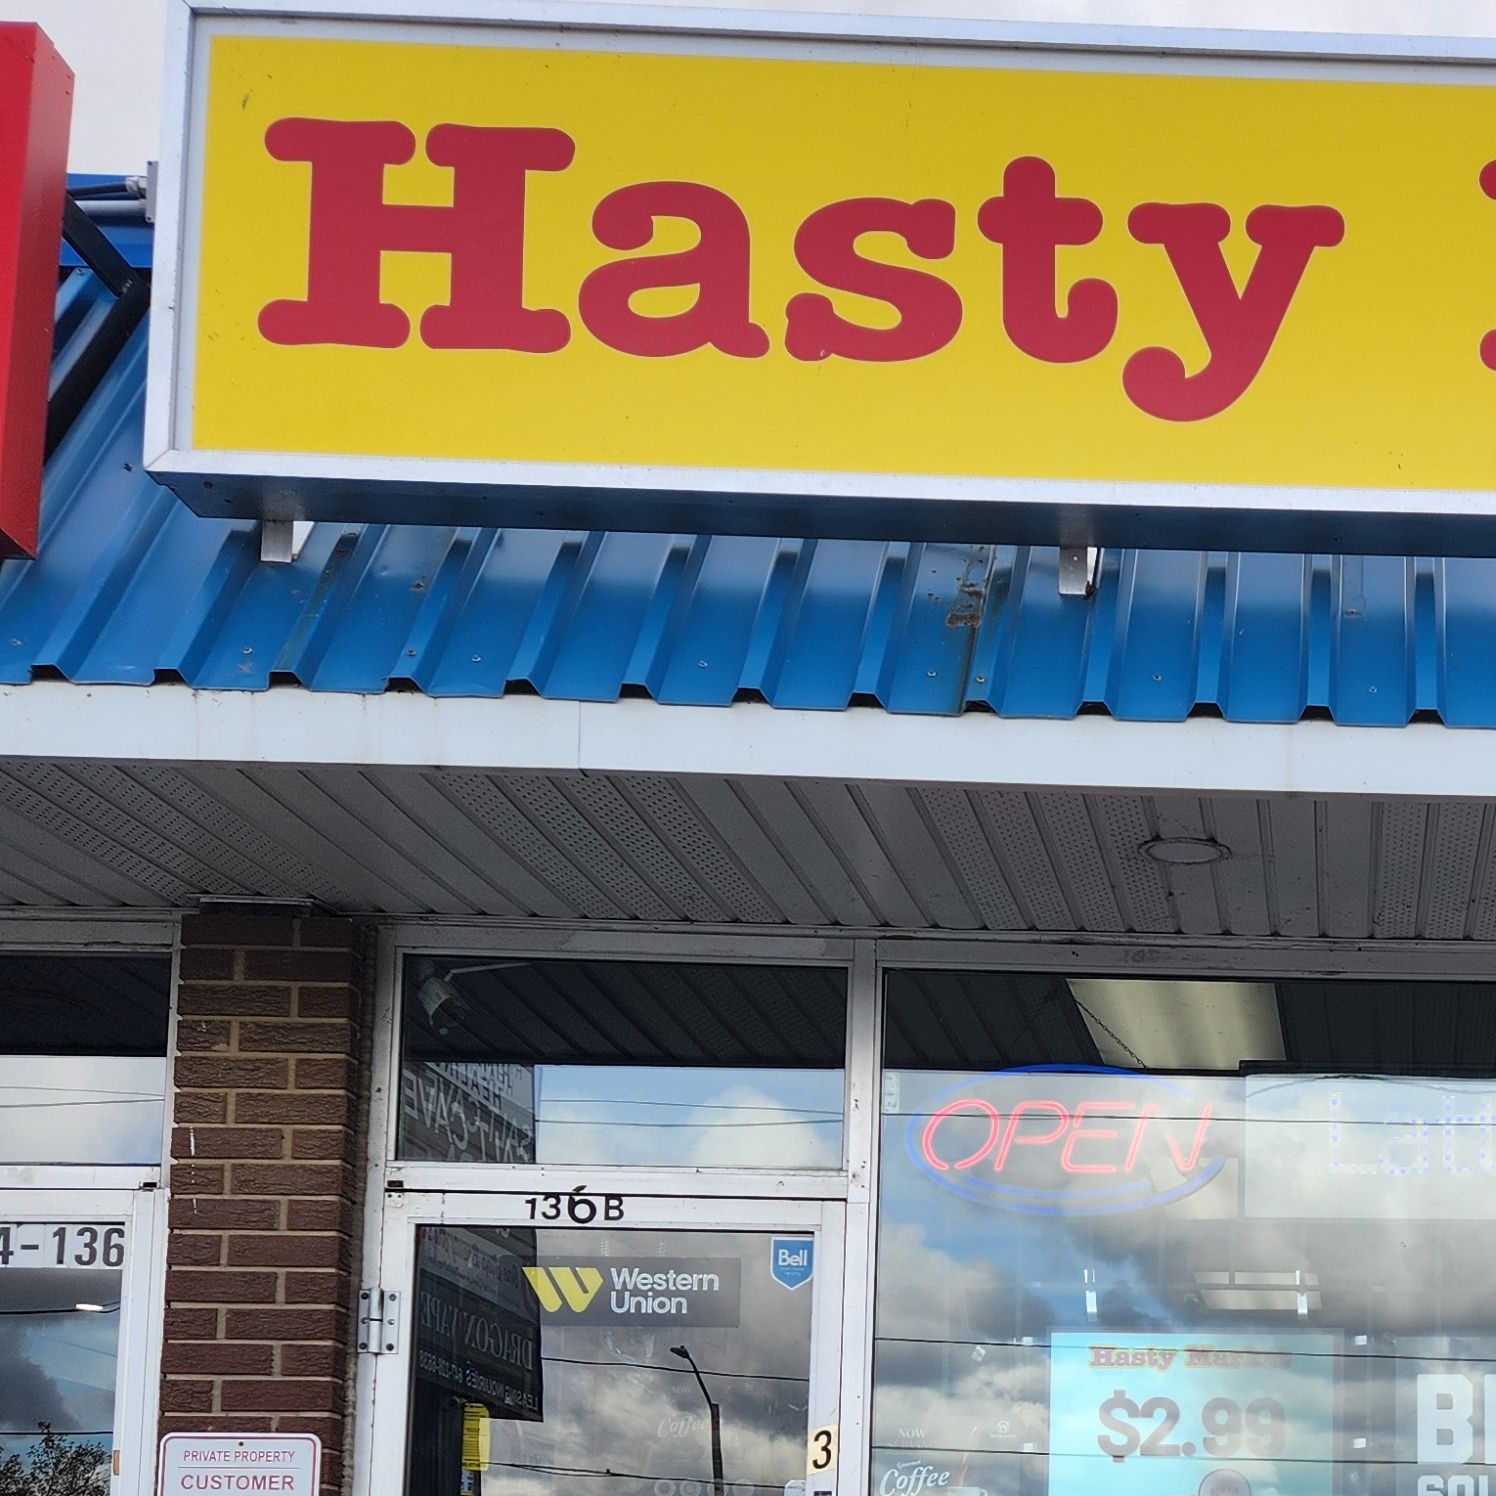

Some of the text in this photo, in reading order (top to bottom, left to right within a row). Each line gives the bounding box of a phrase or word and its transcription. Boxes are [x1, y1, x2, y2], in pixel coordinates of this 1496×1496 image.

[258, 115, 1346, 423] Hasty
[920, 1098, 1214, 1174] OPEN
[778, 1248, 808, 1267] Bell
[610, 1267, 720, 1291] Western
[610, 1291, 688, 1314] Union
[1089, 1345, 1175, 1371] Hasty
[1097, 1389, 1286, 1463] $2.99
[183, 1450, 296, 1462] PRIVATE PROPERTY
[811, 1430, 833, 1470] 3
[180, 1475, 294, 1490] CUSTOMER
